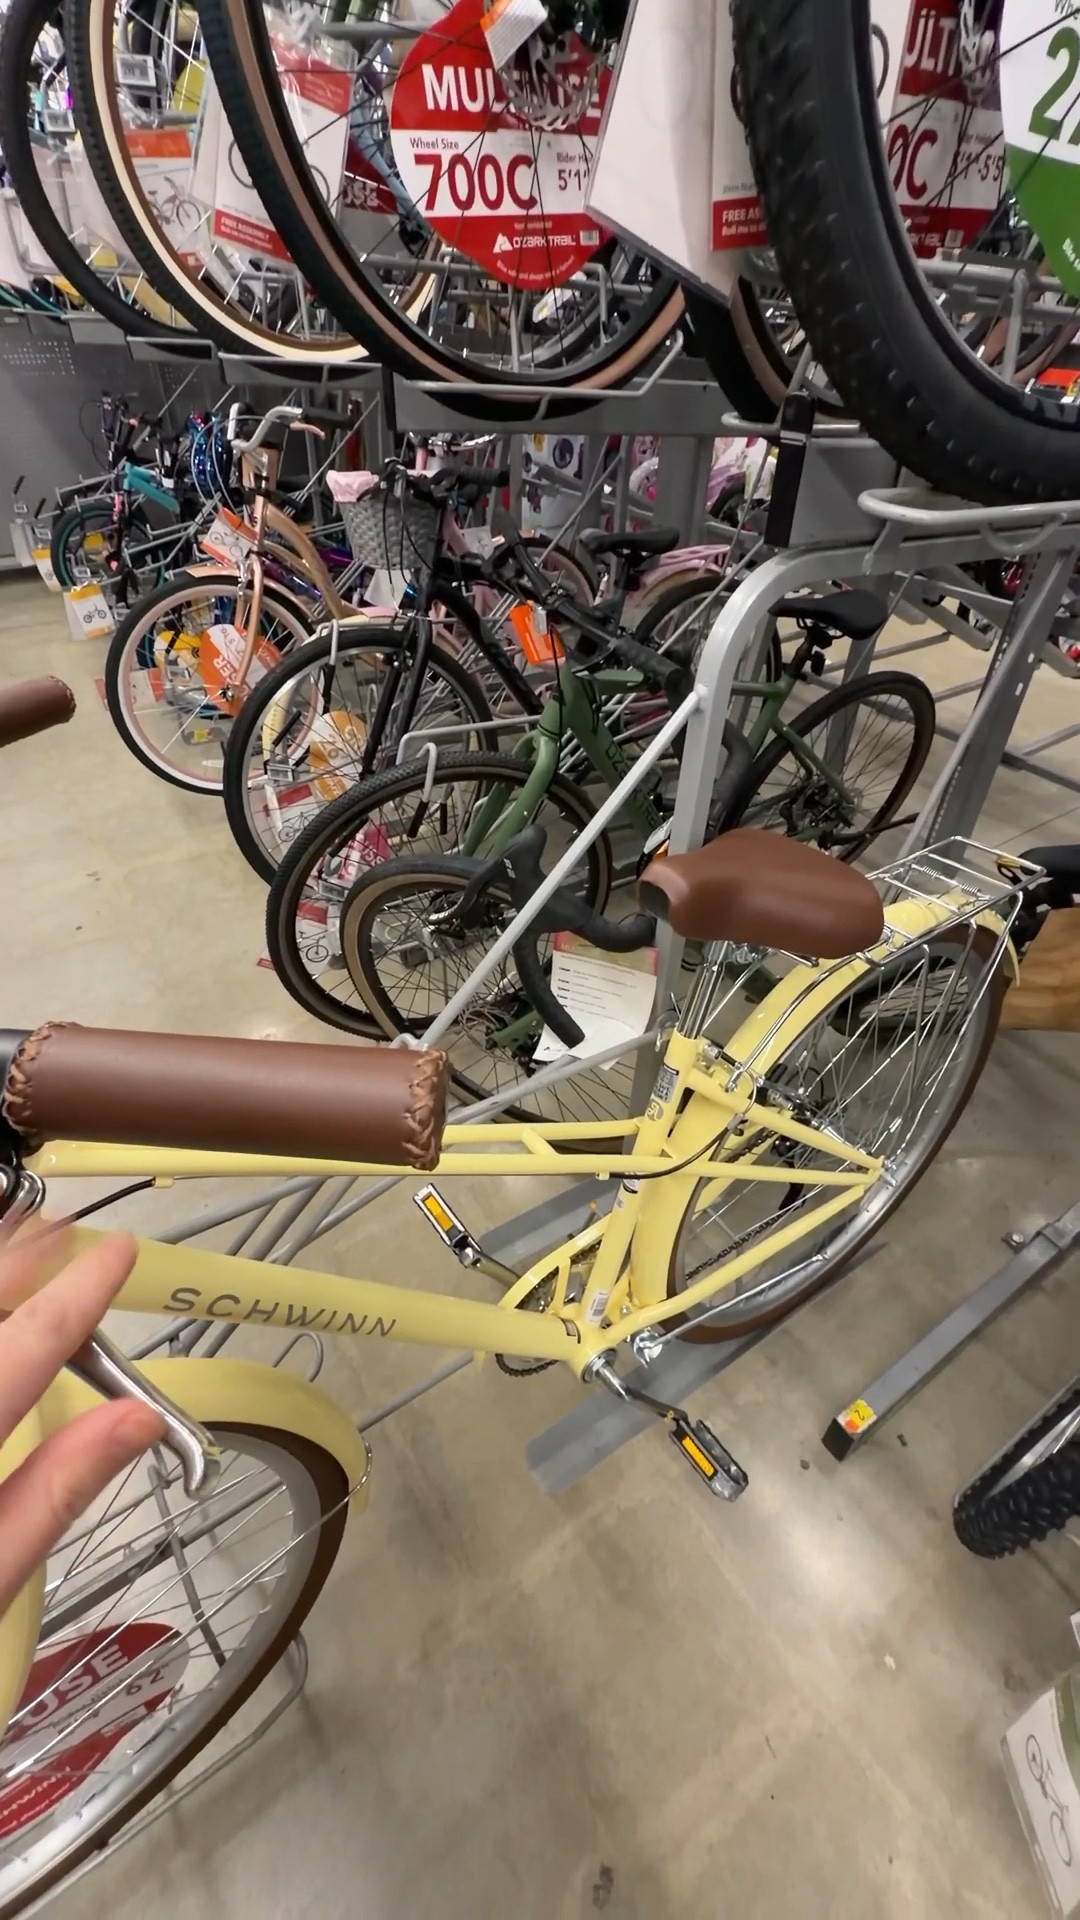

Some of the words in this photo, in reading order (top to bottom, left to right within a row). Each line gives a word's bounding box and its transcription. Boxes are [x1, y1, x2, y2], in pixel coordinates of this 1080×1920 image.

[409, 137, 439, 149] Wheel
[440, 137, 459, 150] Size
[413, 153, 539, 212] 700C
[162, 1287, 397, 1337] SCHWINN
